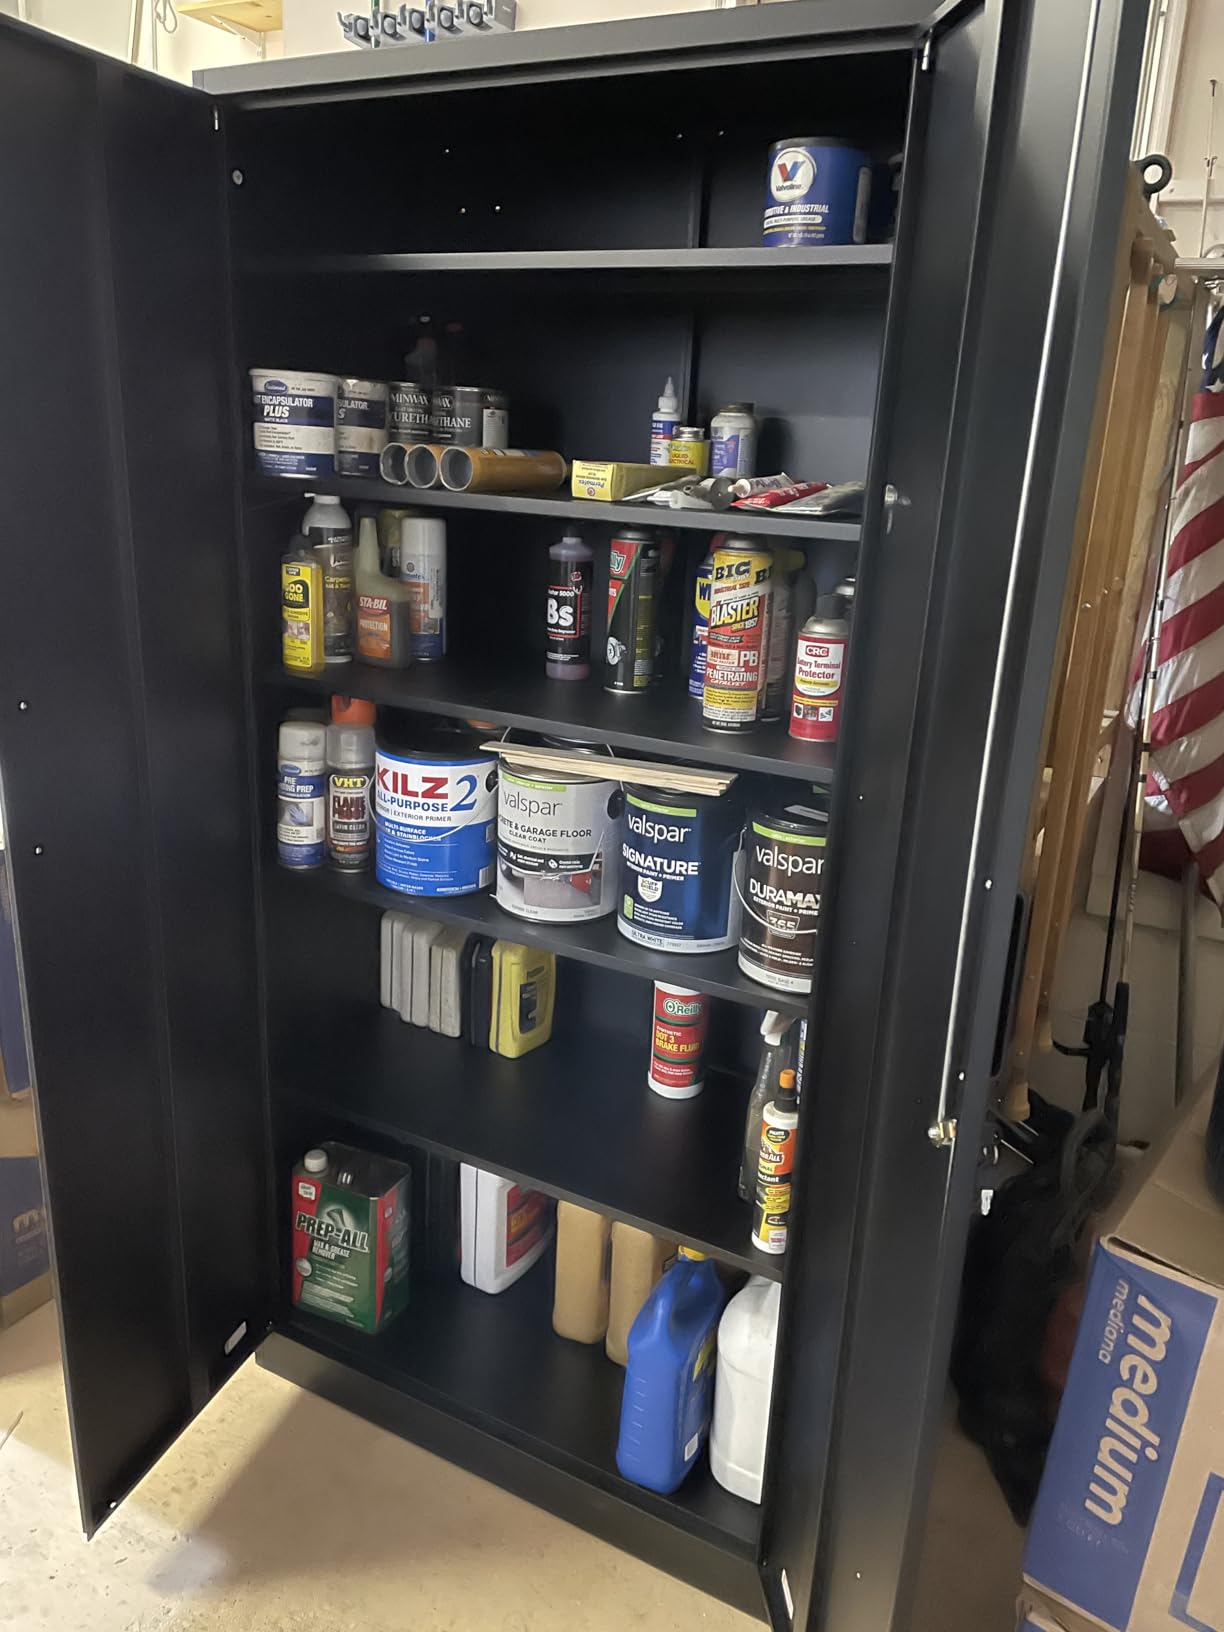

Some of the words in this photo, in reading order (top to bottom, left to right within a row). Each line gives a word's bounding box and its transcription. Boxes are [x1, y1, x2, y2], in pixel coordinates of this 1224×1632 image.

[775, 183, 802, 191] Valvoline
[790, 203, 829, 213] INDUSTRIAL
[261, 395, 313, 408] ENCAPSULATOR
[264, 405, 290, 418] PLUS
[578, 479, 605, 488] Permatex
[715, 560, 752, 580] BIG
[547, 598, 574, 627] Bs
[711, 597, 760, 627] BLASTER
[740, 650, 759, 667] PB
[806, 646, 829, 657] CRC
[814, 660, 841, 669] Terminal
[706, 668, 758, 682] PENETRATING
[798, 667, 835, 680] Protector
[296, 785, 315, 793] PREP
[334, 776, 364, 789] VHT
[376, 763, 449, 799] KILZ
[449, 774, 478, 812] 2
[503, 791, 562, 818] valspar
[393, 810, 424, 821] EXTERIOR
[514, 822, 520, 831] &
[520, 824, 558, 838] GARAGE
[560, 829, 593, 838] FLOOR
[628, 813, 688, 844] valspar
[509, 829, 527, 840] CLEAR
[528, 835, 547, 844] COAT
[622, 842, 699, 876] SIGNATURE
[756, 845, 824, 877] valspar
[643, 868, 658, 877] PAINT
[662, 873, 684, 881] PRIMER
[775, 904, 793, 913] PAINT
[631, 930, 647, 940] ULTRA
[656, 1030, 668, 1041] DOT
[669, 1035, 675, 1043] 3
[656, 1037, 679, 1052] BRAKE
[296, 1210, 370, 1253] PREP-ALL
[1098, 1279, 1129, 1365] mediana
[1084, 1295, 1173, 1526] medium
